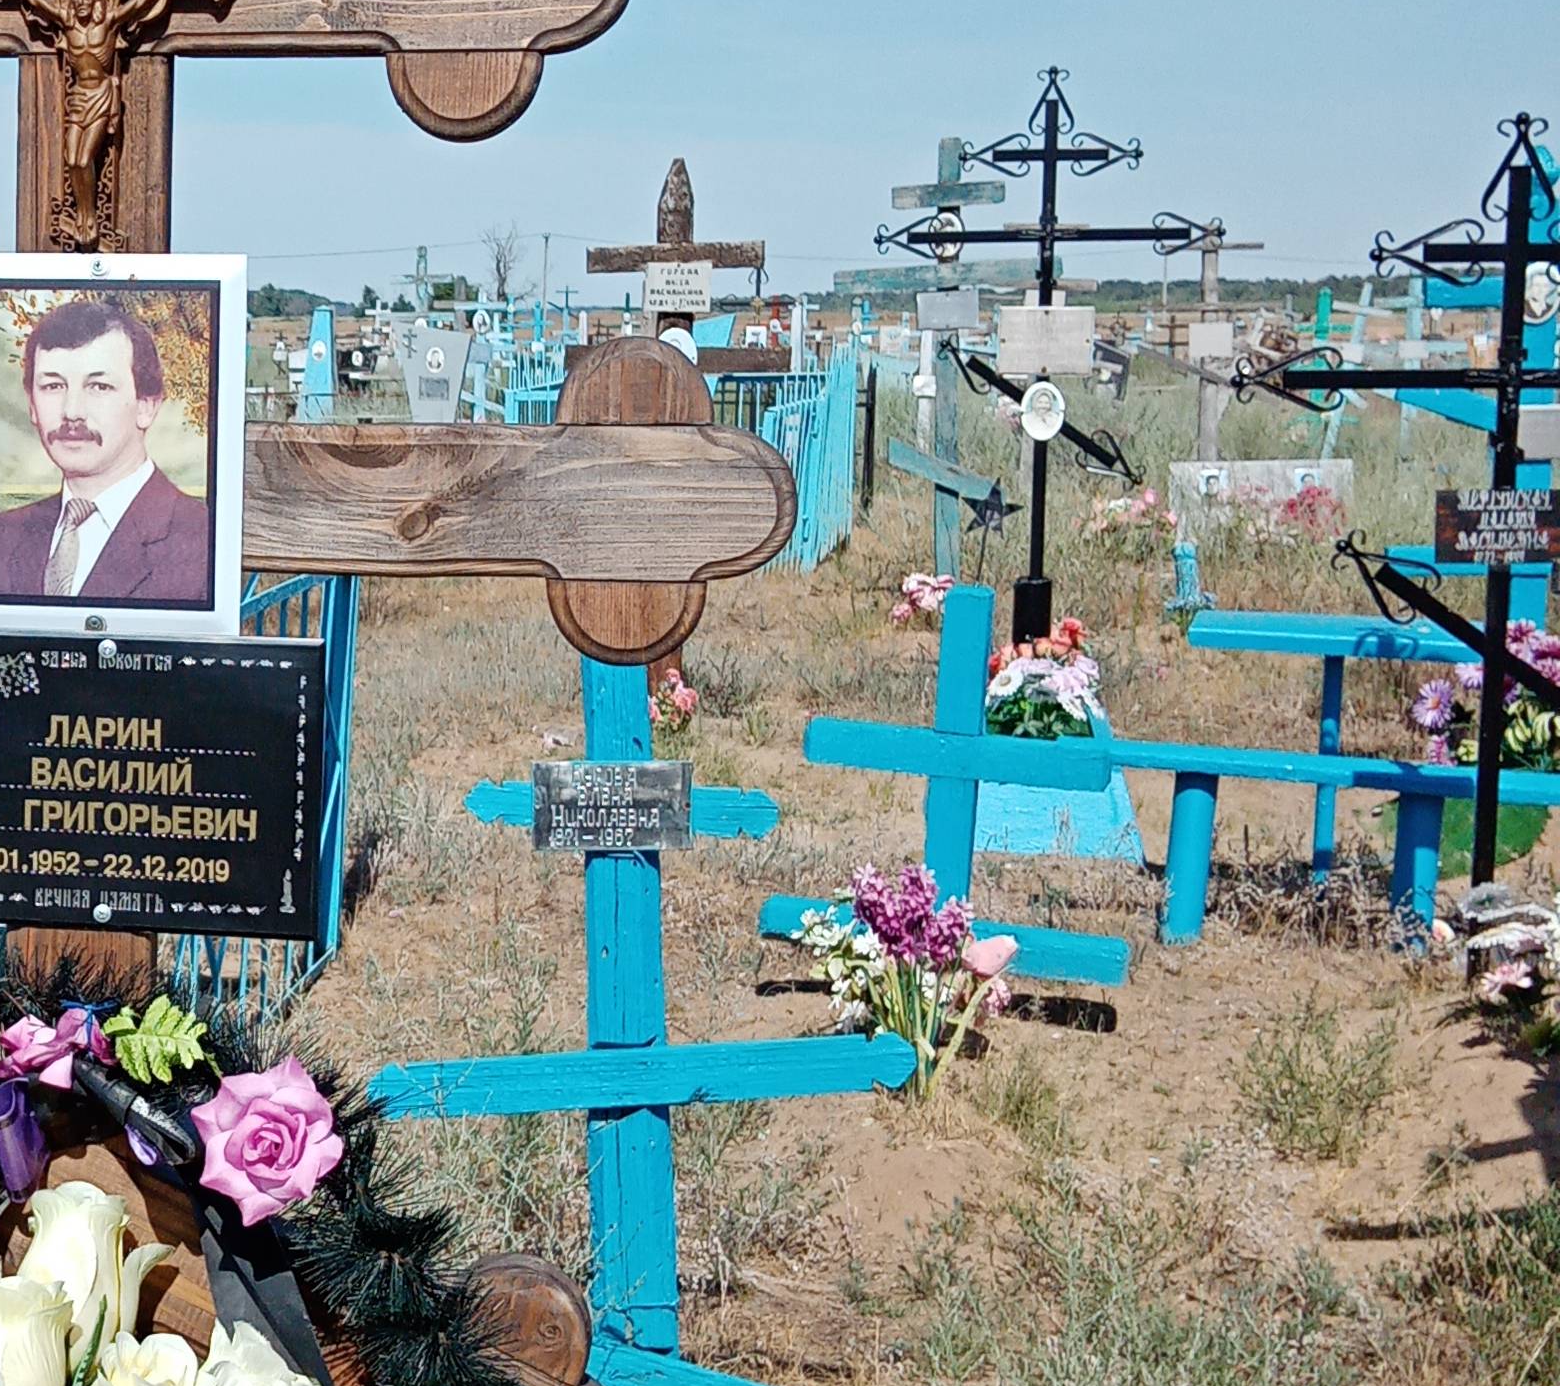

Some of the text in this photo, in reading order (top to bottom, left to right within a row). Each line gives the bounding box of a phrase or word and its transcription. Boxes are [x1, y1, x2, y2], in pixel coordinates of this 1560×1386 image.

[40, 650, 173, 672] ЗДЕСЬ ПОКОИТСЯ
[44, 714, 162, 750] ЛАРИН
[31, 756, 192, 795] ВАСИЛИЙ
[23, 798, 258, 841] ГРИГОРЬЕВИЧ
[34, 887, 164, 913] ВЕЧНАЯ ПАМЯТЬ
